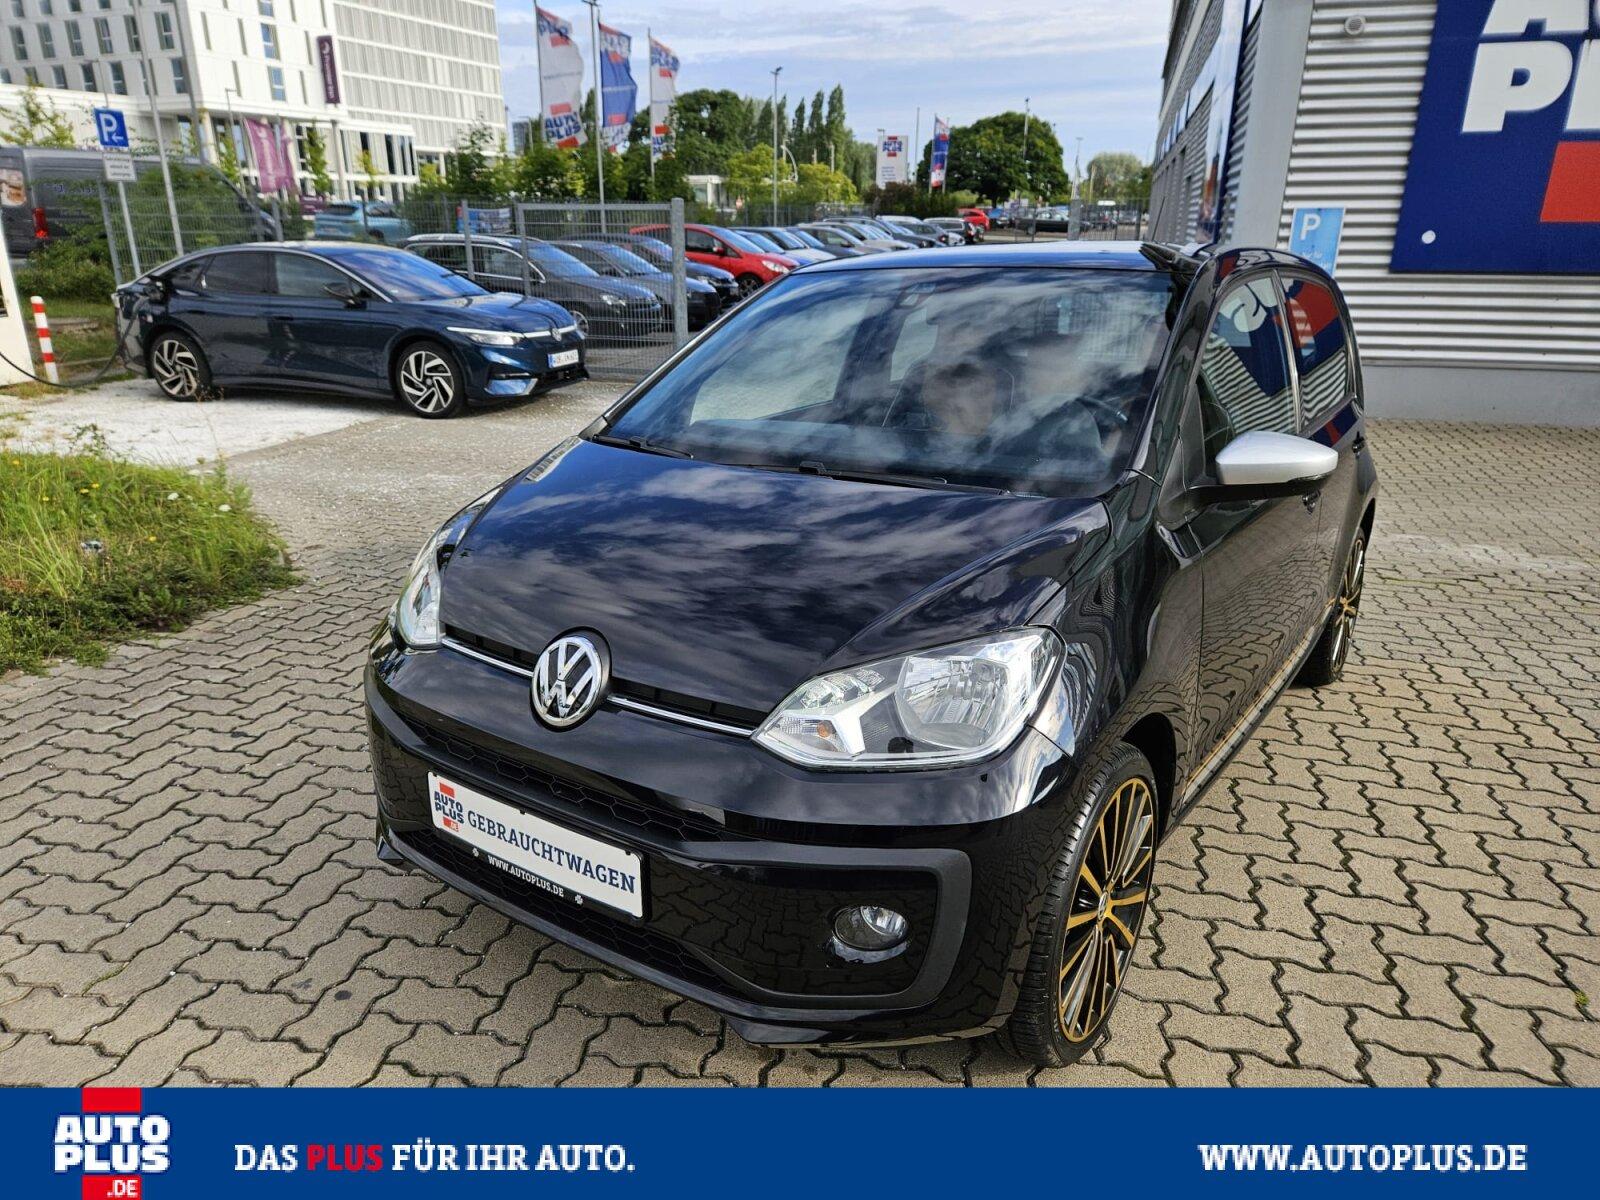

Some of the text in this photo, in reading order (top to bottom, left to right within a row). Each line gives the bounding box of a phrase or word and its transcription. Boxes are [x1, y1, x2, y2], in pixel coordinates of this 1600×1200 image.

[99, 113, 117, 142] P
[1300, 213, 1321, 240] P
[434, 791, 463, 813] AUTO
[435, 801, 464, 824] PLUS
[467, 810, 635, 893] GEBRAUCHTWAGEN
[487, 854, 564, 898] WWW.AUTOPLUS.DE
